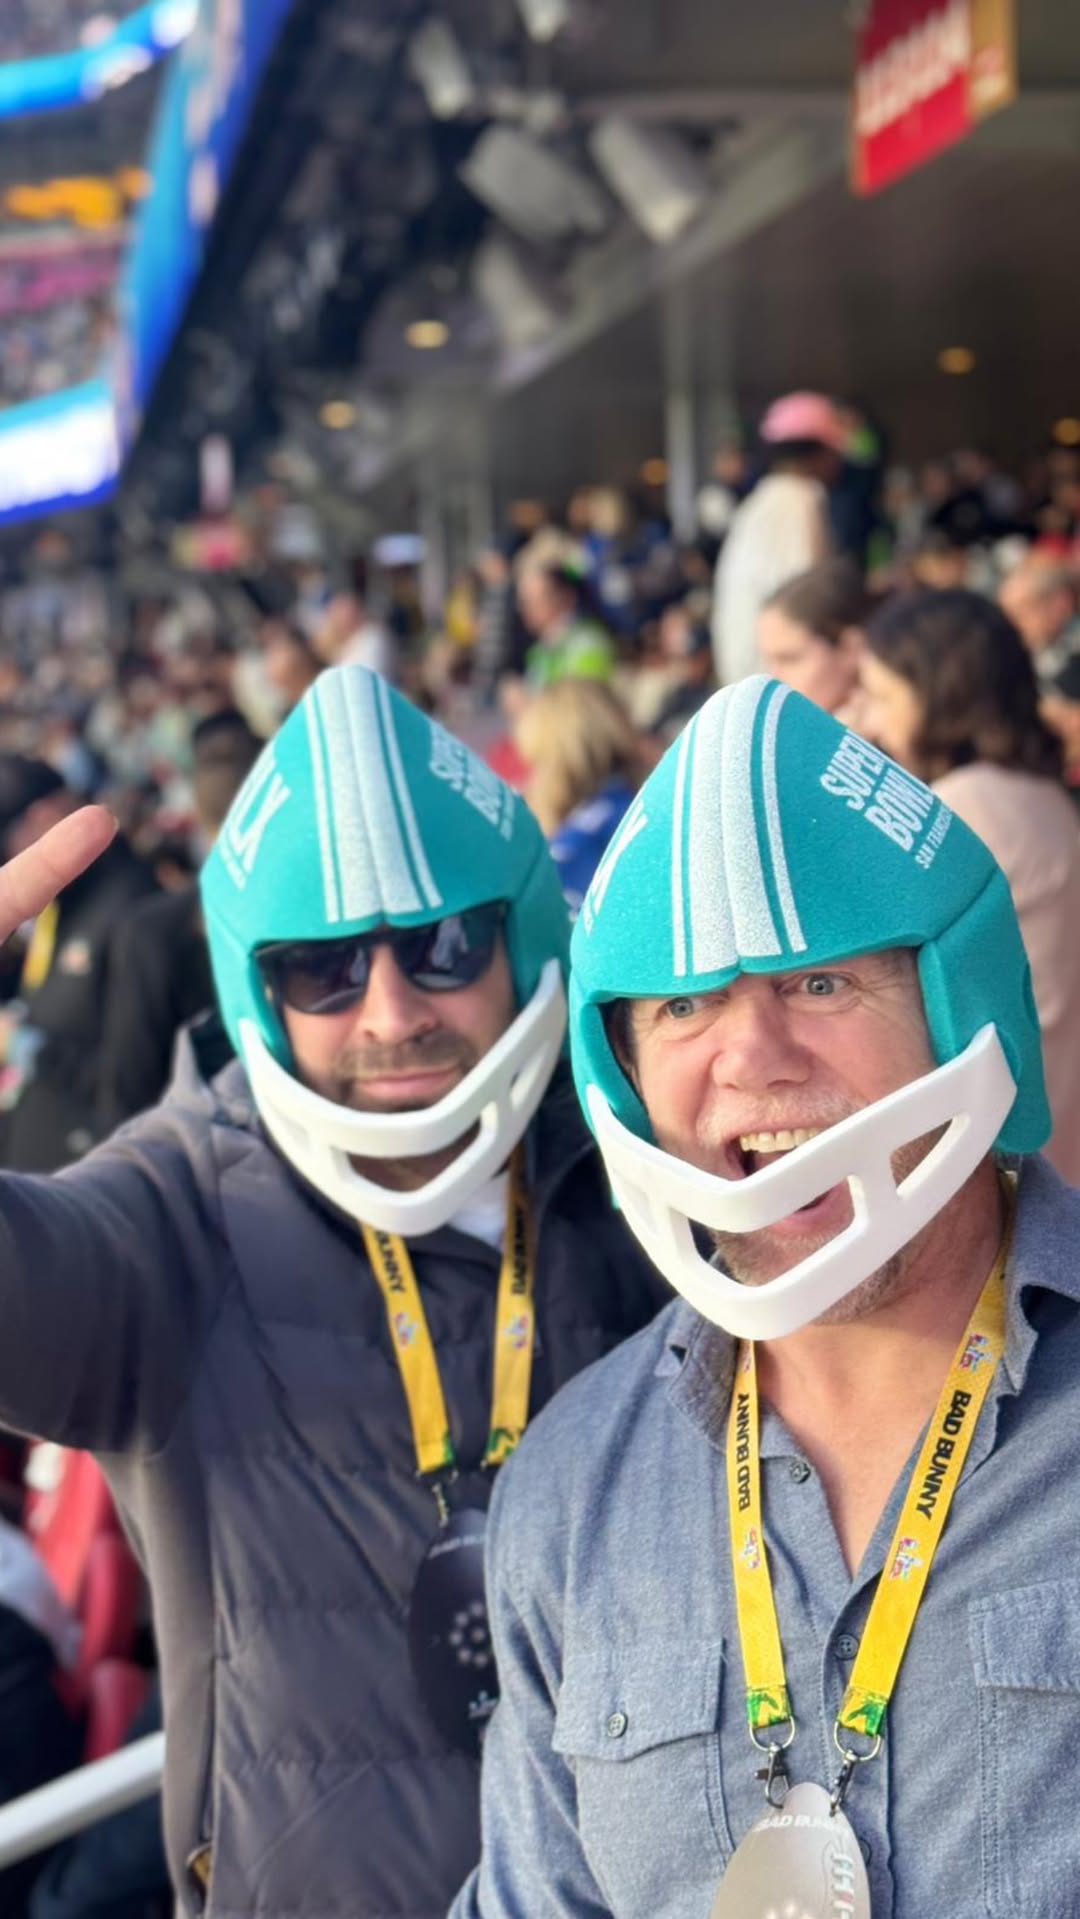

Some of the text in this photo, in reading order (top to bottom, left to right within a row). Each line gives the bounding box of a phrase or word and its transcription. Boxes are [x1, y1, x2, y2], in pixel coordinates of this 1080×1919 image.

[864, 767, 934, 852] BOWL
[736, 1393, 751, 1511] BAD BUNNY
[916, 1389, 972, 1521] BAD BUNNY
